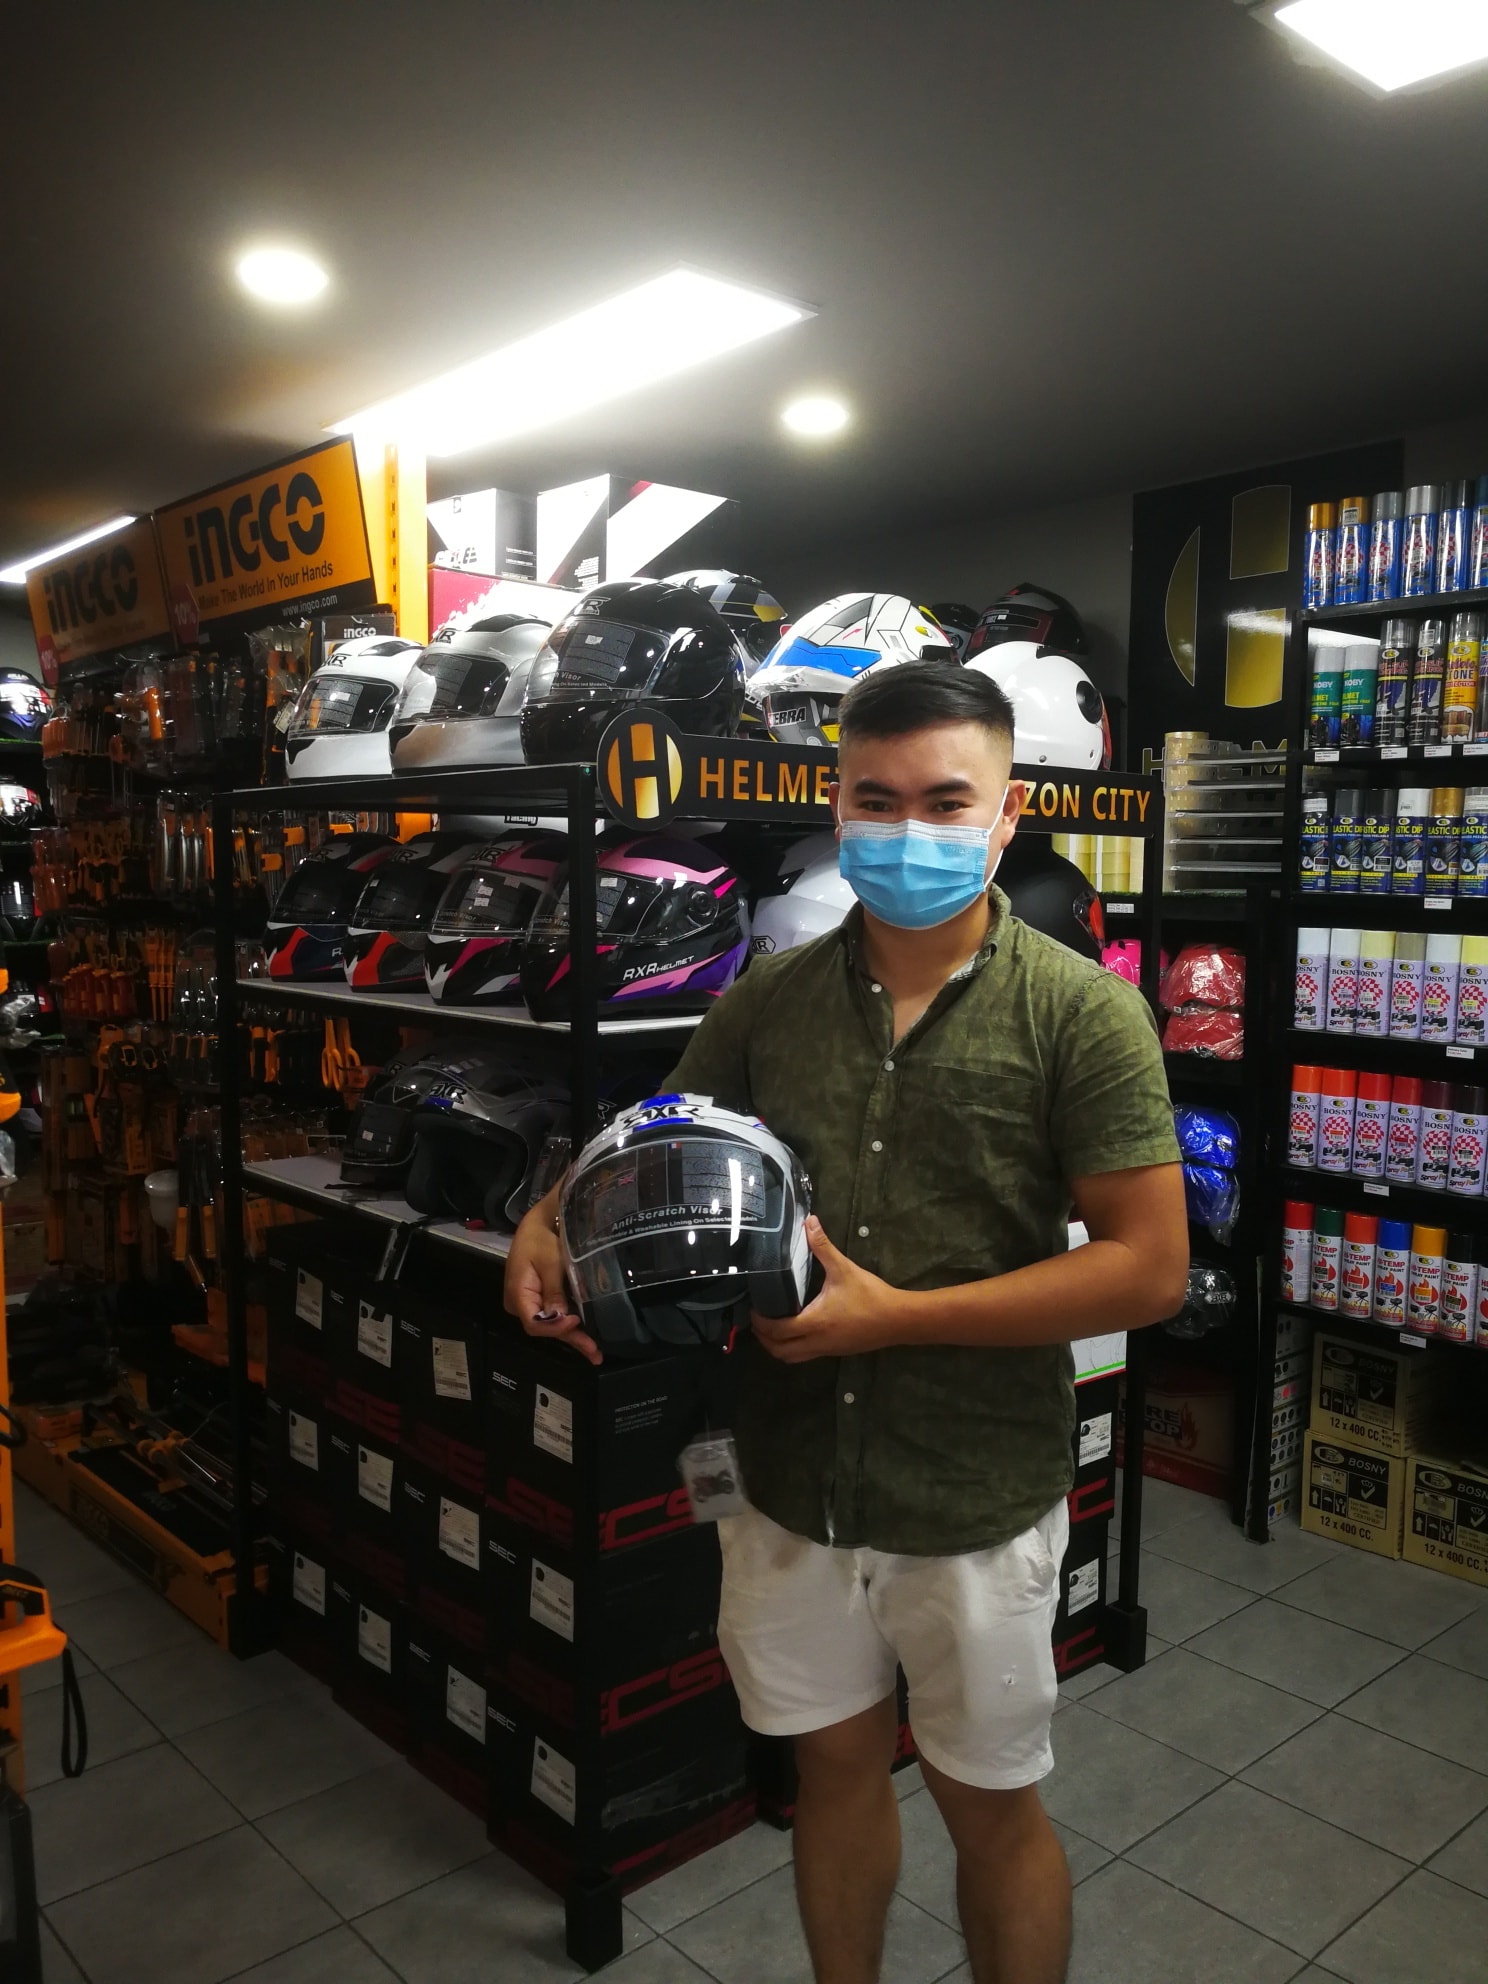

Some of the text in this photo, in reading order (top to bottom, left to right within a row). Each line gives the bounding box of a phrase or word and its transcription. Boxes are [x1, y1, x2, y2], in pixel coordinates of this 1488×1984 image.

[220, 587, 238, 603] The
[240, 582, 265, 600] World
[267, 579, 276, 593] In
[276, 573, 300, 591] Your
[301, 560, 334, 585] Hands
[174, 603, 196, 625] 10%
[281, 594, 338, 618] www.ingco.com
[1447, 669, 1474, 679] TONE
[769, 707, 807, 728] EBRA
[700, 757, 839, 805] HELME
[1092, 786, 1151, 823] CITY
[1378, 826, 1390, 834] DIP
[1411, 826, 1424, 834] DIP
[623, 955, 695, 981] RXR HELMET
[1329, 1019, 1344, 1027] Spray
[1323, 1107, 1353, 1116] BOSNY
[1357, 1111, 1386, 1120] BOSNY
[1454, 1126, 1486, 1136] BOSNY
[1321, 1158, 1337, 1166] Spray
[1353, 1161, 1368, 1169] Spray
[1421, 1173, 1438, 1182] Spray
[1449, 1179, 1466, 1187] Spray
[611, 1206, 686, 1232] Anti-Scratch
[669, 1218, 693, 1228] Lining
[693, 1217, 704, 1225] On
[492, 1371, 518, 1390] SEC
[1330, 1416, 1341, 1429] 12
[1350, 1422, 1365, 1437] 400
[1348, 1457, 1387, 1476] BOSNY
[1457, 1483, 1488, 1501] BOSN
[1320, 1515, 1331, 1527] 12
[1340, 1522, 1357, 1536] 400
[488, 1540, 517, 1565] SEC
[1424, 1543, 1435, 1556] 12
[1446, 1549, 1464, 1565] 400
[487, 1705, 517, 1733] SEC
